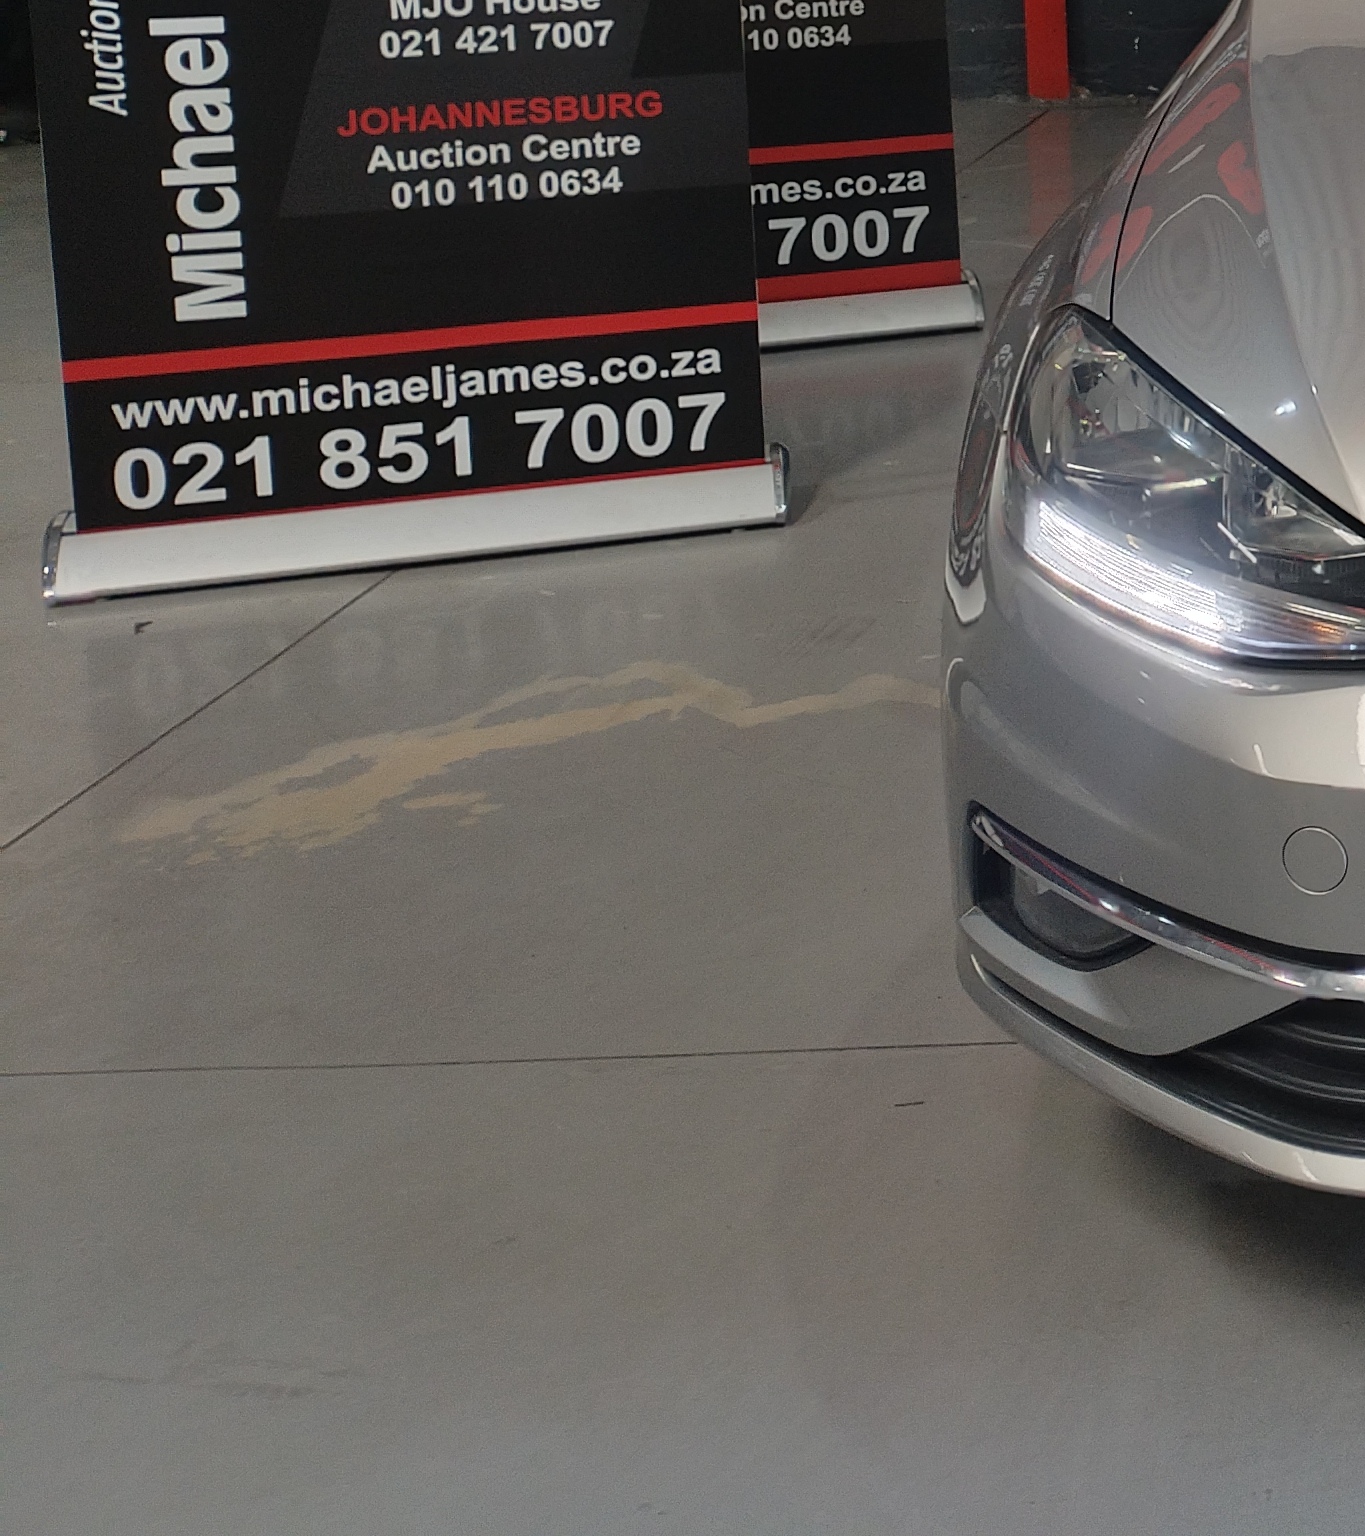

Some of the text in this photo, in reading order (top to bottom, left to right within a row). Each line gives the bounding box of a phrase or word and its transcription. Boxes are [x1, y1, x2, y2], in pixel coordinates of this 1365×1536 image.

[380, 20, 614, 58] 021 421 7007
[788, 24, 851, 48] 0634
[338, 90, 662, 137] JOHANNESBURG
[148, 16, 247, 321] Michael
[367, 132, 640, 173] Auction Centre
[392, 166, 623, 209] 010 110 0634
[768, 206, 929, 265] 7007
[112, 348, 723, 431] www.michaeljames.co.za
[114, 392, 725, 509] 021 851 7007
